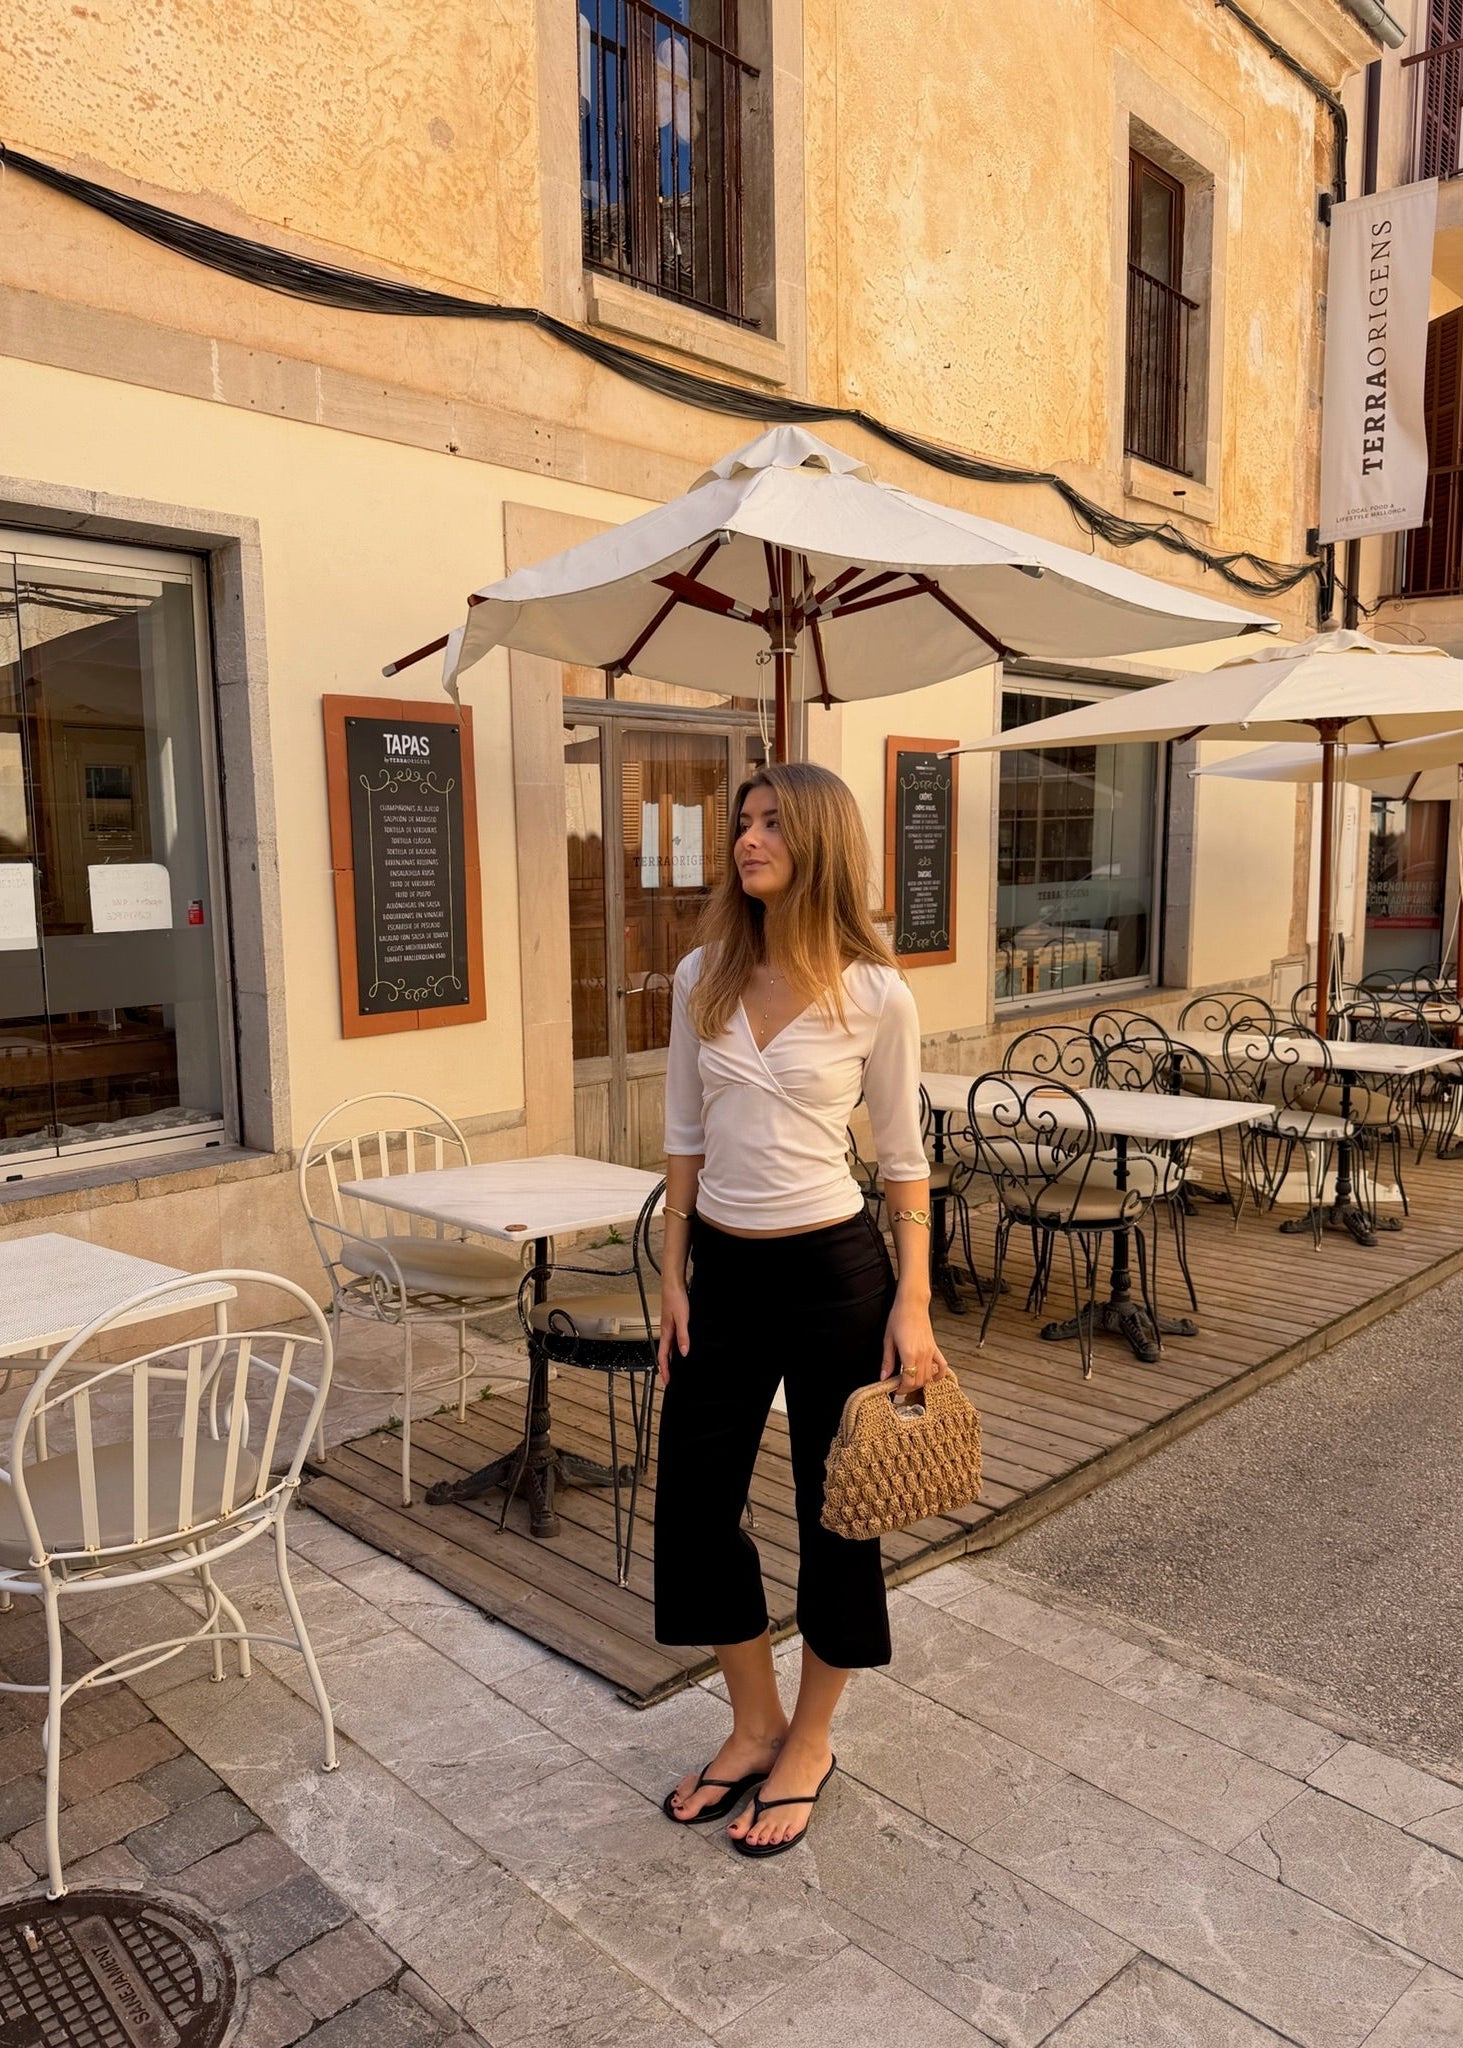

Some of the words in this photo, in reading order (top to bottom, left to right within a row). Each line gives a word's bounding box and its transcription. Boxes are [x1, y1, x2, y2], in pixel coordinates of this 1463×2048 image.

[1362, 220, 1392, 476] TERRAORIGENS
[1336, 514, 1368, 523] LIFESTYLE
[1371, 507, 1406, 517] MALLORCA
[383, 734, 430, 756] TAPAS
[91, 1945, 150, 2024] SANEJAMENT
